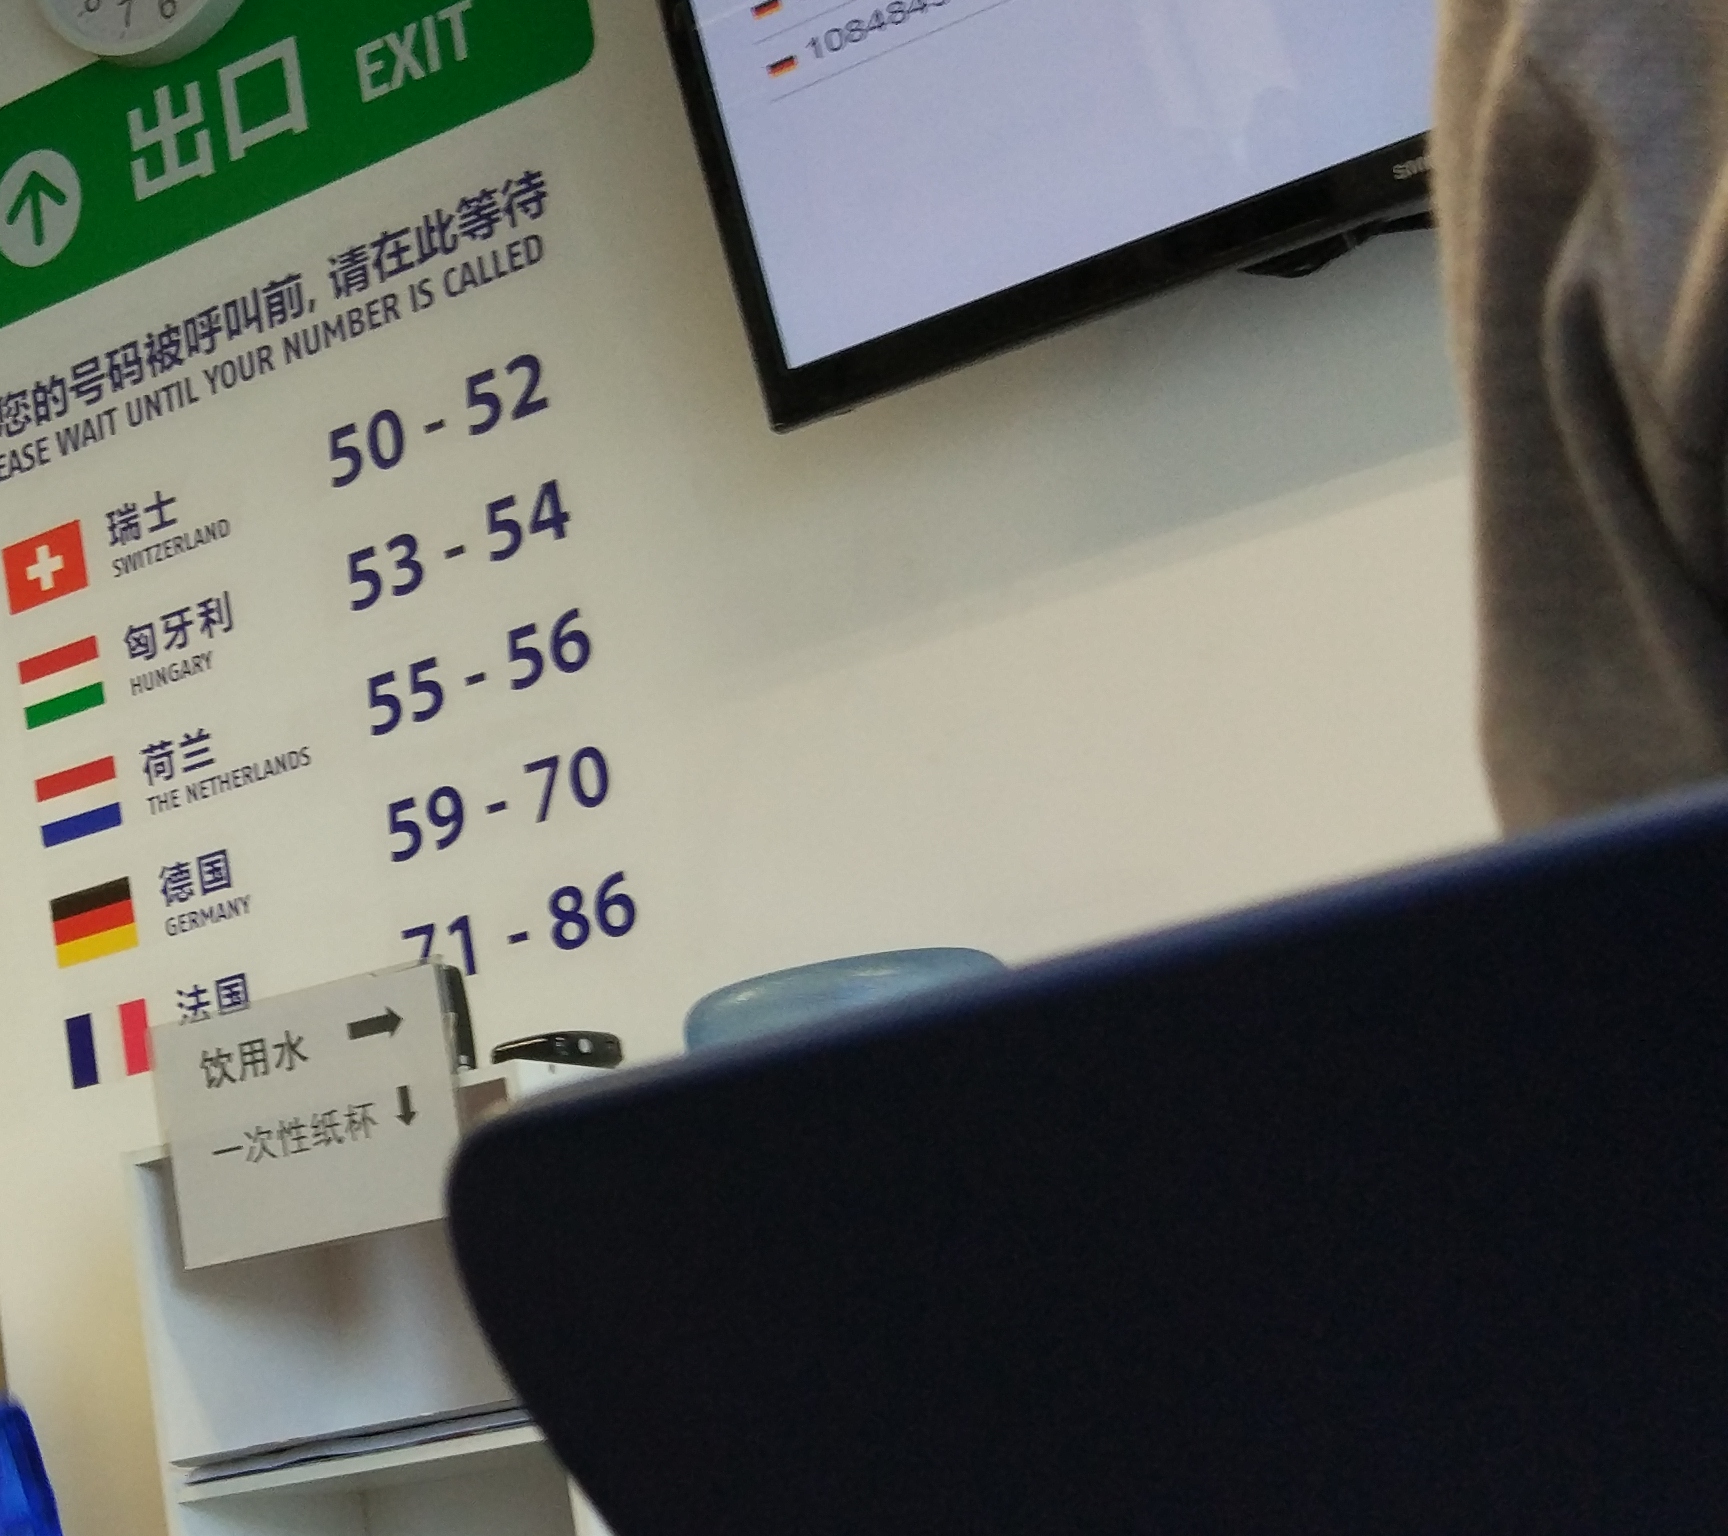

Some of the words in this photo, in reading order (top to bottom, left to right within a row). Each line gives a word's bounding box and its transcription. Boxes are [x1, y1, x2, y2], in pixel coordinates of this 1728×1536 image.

[126, 35, 308, 201] 出口
[55, 407, 118, 456] WAIT
[125, 377, 199, 428] UNTIL
[203, 344, 276, 395] YOUR
[281, 293, 401, 365] NUMBER
[408, 277, 435, 312] IS
[443, 234, 544, 298] CALLED
[327, 409, 405, 488] 50
[465, 353, 550, 436] 52
[105, 490, 178, 546] 瑞士
[111, 518, 232, 578] SWITZERLAND
[347, 533, 425, 611] 53
[485, 478, 571, 562] 54
[122, 590, 234, 660] 匈牙利
[129, 650, 214, 696] HUNGARY
[367, 656, 444, 736] 55
[506, 607, 591, 690] 56
[139, 727, 216, 787] 荷兰
[146, 788, 182, 815] THE
[185, 746, 312, 804] NETHERLANDS
[387, 785, 465, 862] 59
[523, 746, 610, 823] 70
[158, 848, 233, 907] 德国
[164, 894, 251, 937] GERMANY
[548, 870, 637, 951] 86
[176, 972, 250, 1026] 法国
[199, 1029, 309, 1089] 饮用水
[211, 1102, 379, 1163] 一次性纸杯
